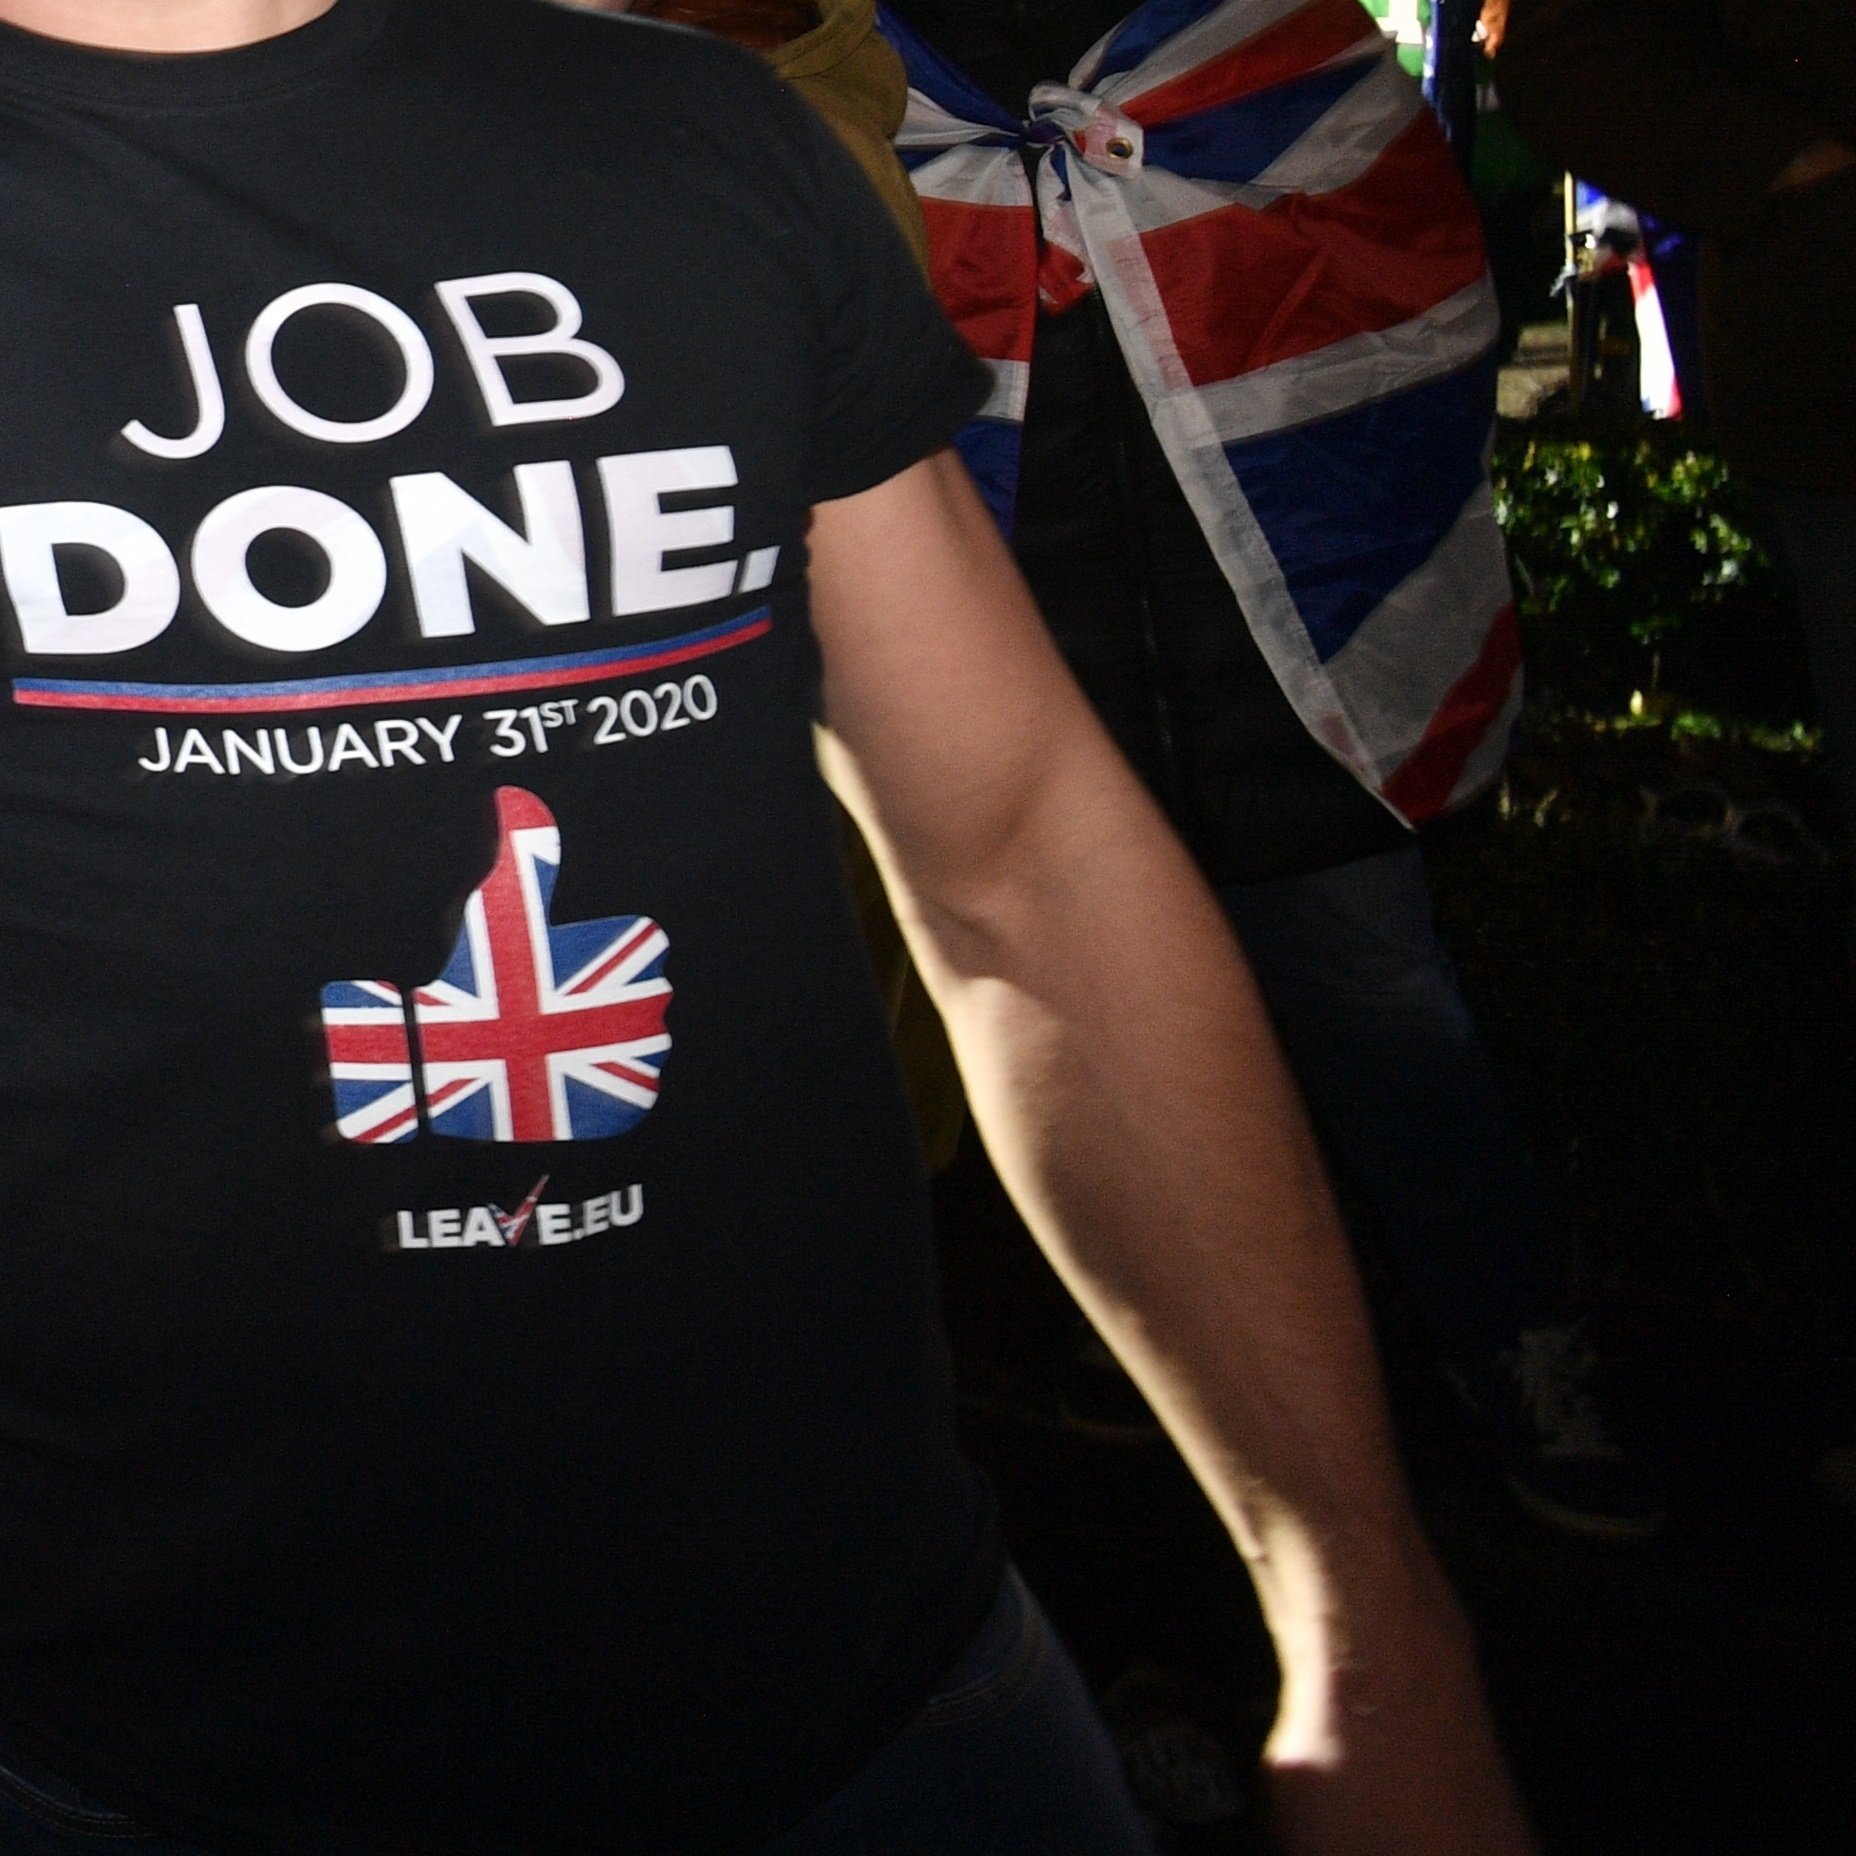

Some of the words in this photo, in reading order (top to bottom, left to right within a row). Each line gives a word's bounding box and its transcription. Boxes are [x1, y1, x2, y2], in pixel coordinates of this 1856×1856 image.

[122, 271, 626, 460] JOB
[138, 713, 463, 776] JANUARY
[483, 698, 579, 758] 31ST
[587, 673, 718, 746] 2020
